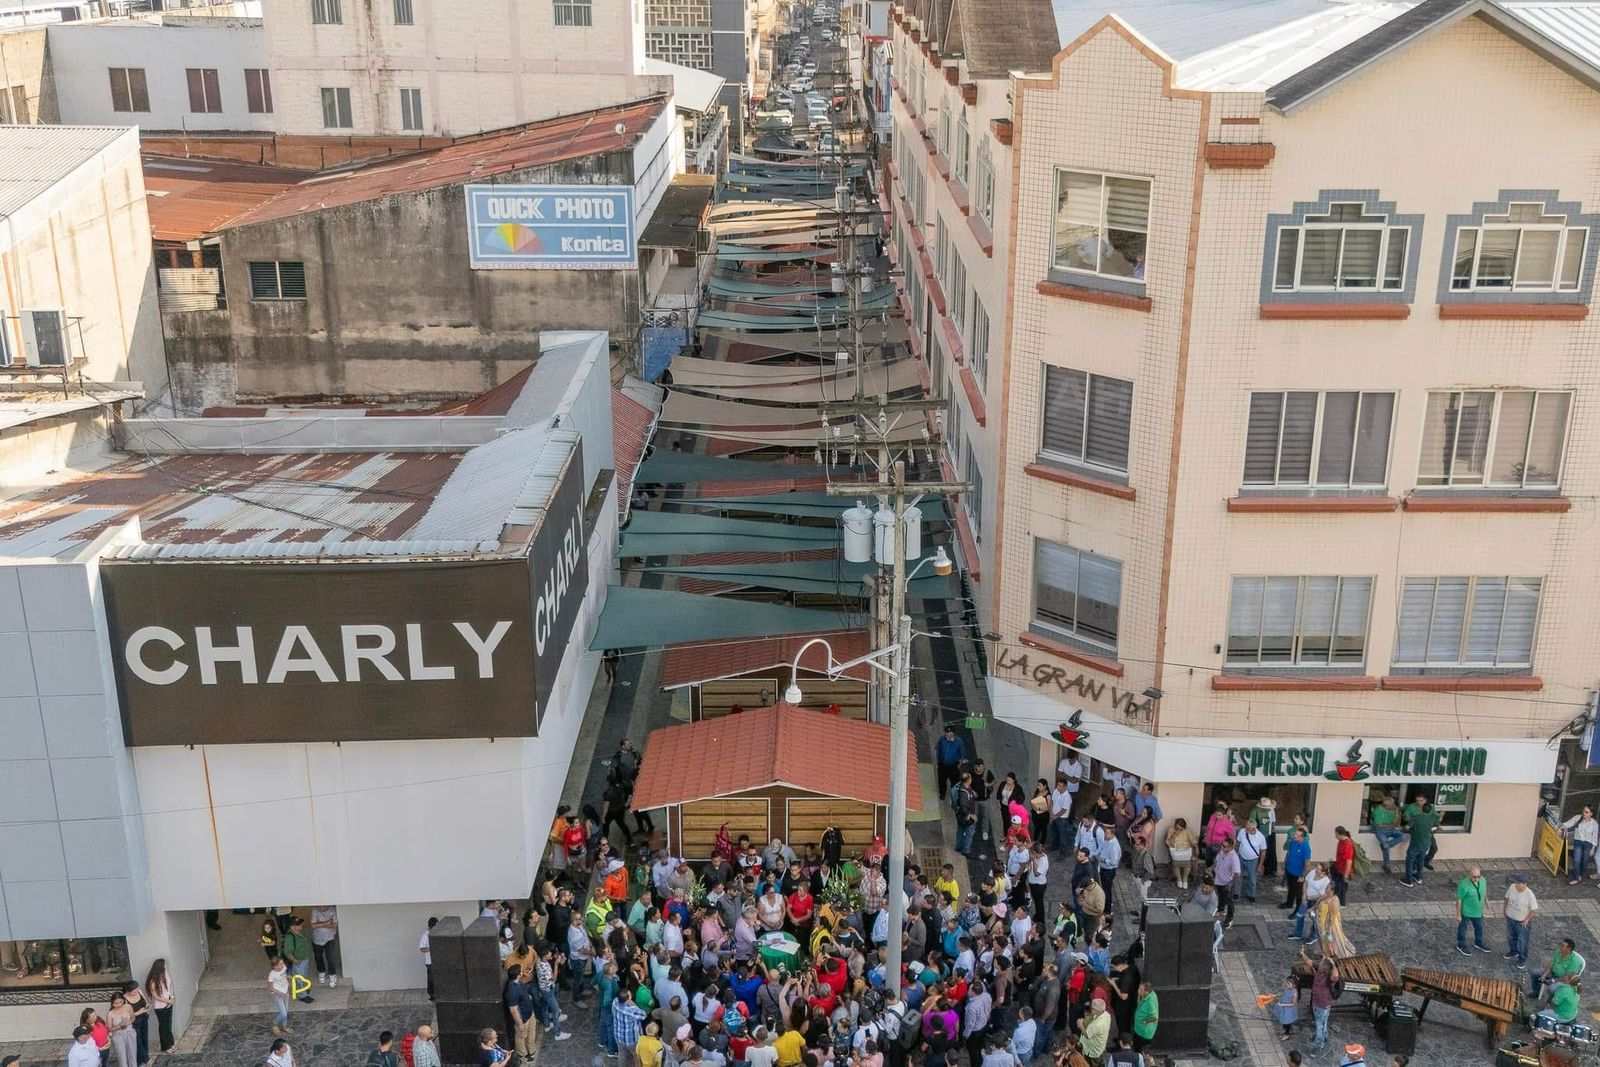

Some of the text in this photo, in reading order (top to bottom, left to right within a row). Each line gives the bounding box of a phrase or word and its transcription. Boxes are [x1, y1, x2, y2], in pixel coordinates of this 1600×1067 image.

[487, 198, 615, 220] QUICK PHOTO
[561, 236, 624, 252] Konica
[535, 491, 584, 657] CHARLY
[125, 621, 513, 685] CHARLY
[996, 648, 1028, 675] LA
[1032, 663, 1106, 702] GRAN
[1227, 747, 1488, 776] ESPRESSO AMERICANO
